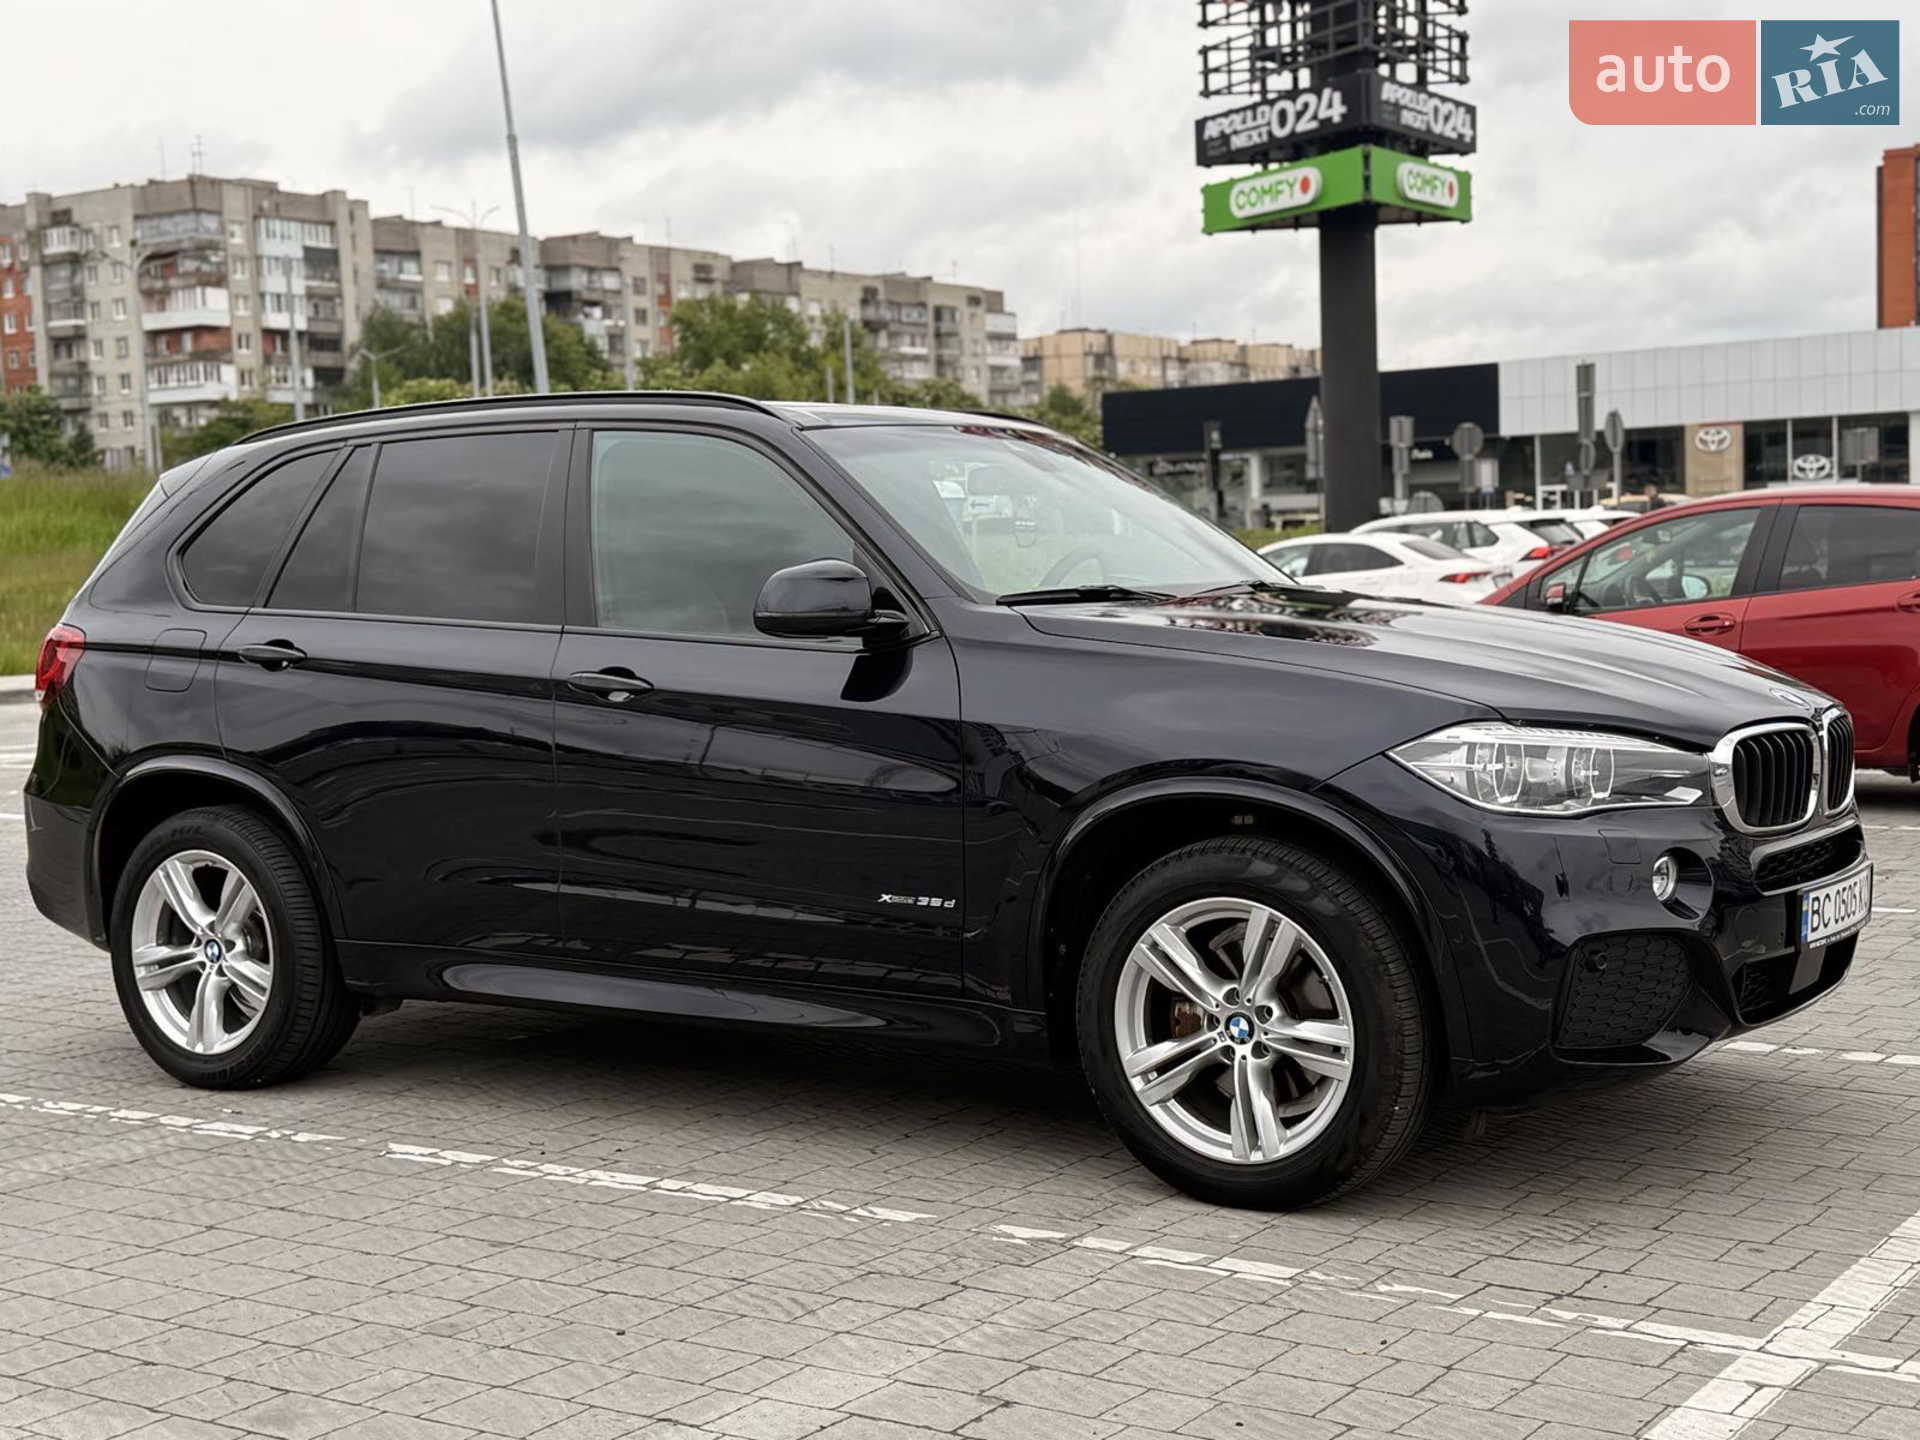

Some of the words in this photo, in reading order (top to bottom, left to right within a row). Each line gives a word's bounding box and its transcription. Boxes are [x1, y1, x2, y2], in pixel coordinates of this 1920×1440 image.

[1203, 105, 1271, 141] APOLLO
[1270, 87, 1347, 138] 024
[1428, 97, 1474, 143] 024
[1230, 125, 1270, 150] NEXT
[1235, 177, 1298, 210] COMFY
[1405, 168, 1446, 199] COMFY
[1810, 893, 1831, 933] BC
[1834, 881, 1858, 924] 0505
